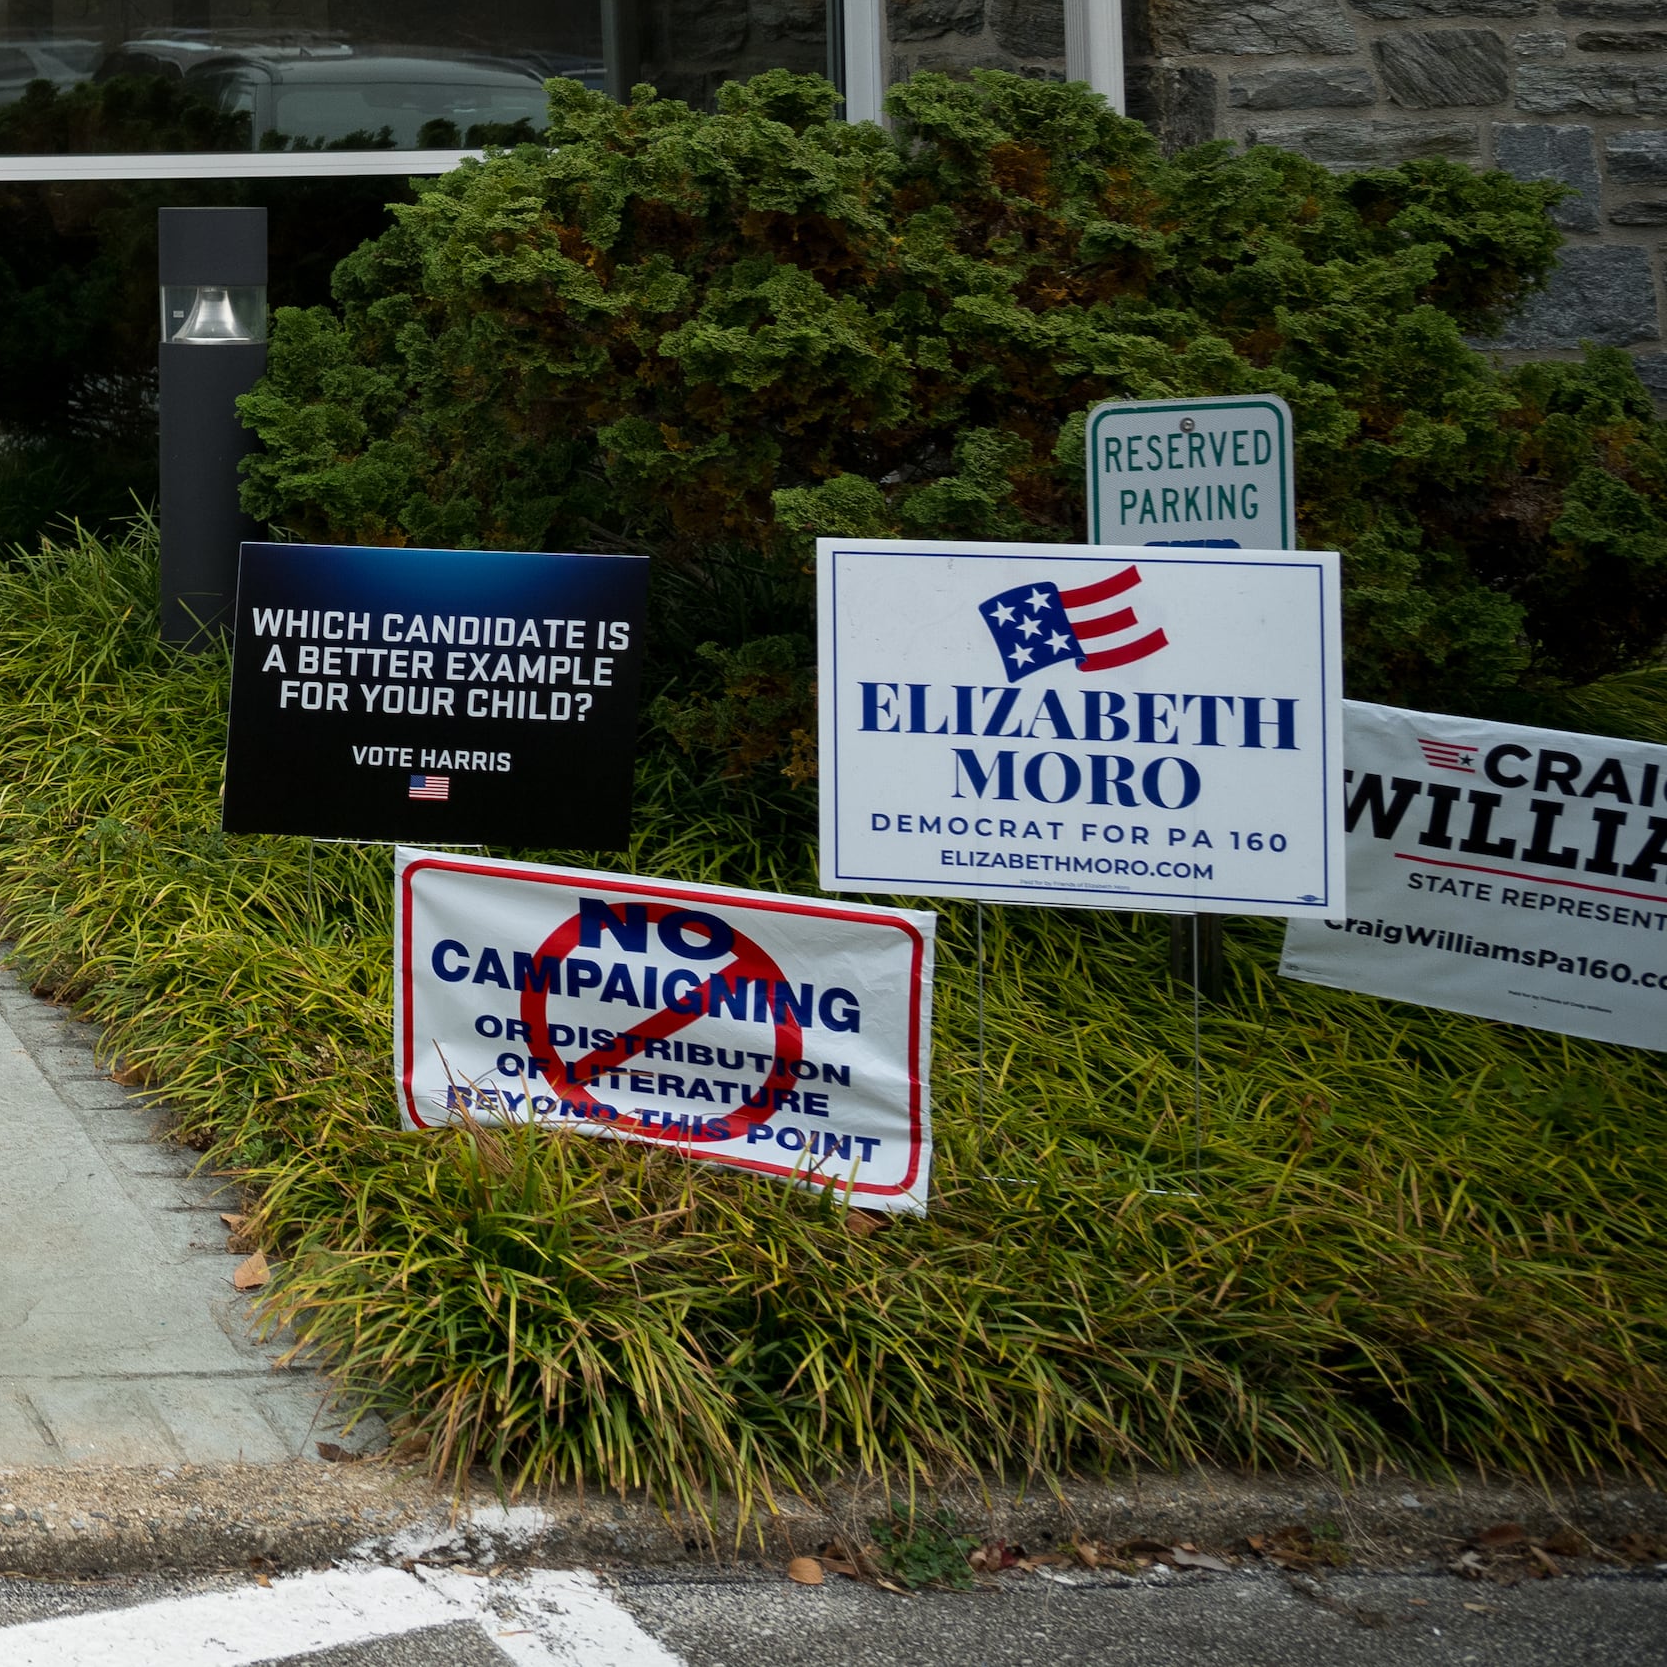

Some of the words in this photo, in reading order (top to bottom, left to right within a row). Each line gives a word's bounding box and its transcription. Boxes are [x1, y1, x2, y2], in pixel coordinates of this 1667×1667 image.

[1105, 429, 1272, 473] RESERVED
[1120, 483, 1259, 525] PARKING
[252, 607, 370, 641] WHICH
[382, 613, 586, 649] CANDIDATE
[596, 621, 630, 651] IS
[261, 643, 287, 673] A
[298, 645, 433, 680] BETTER
[446, 652, 614, 687] EXAMPLE
[279, 680, 348, 712] FOR
[360, 684, 455, 717] YOUR
[466, 688, 592, 722] CHILD?
[857, 681, 1301, 751] ELIZABETH
[352, 745, 413, 768] VOTE
[420, 749, 511, 772] HARRIS
[950, 748, 1201, 810] MORO
[1483, 743, 1667, 808] CRAI
[870, 812, 1064, 841] DEMOCRAT
[1081, 823, 1150, 846] FOR
[1168, 827, 1213, 849] PA
[1230, 831, 1288, 853] 160
[1343, 769, 1667, 883] WILLIA
[940, 849, 1213, 880] ELIZABETHMORO.COM
[579, 897, 734, 960] NO
[1407, 872, 1492, 902] STATE
[1500, 887, 1667, 931] REPRESENT
[431, 939, 861, 1034] CAMPAIGNING
[474, 1014, 532, 1044] OR
[549, 1024, 850, 1087] DISTRIBUTION
[496, 1052, 549, 1080] OF
[566, 1061, 829, 1118] LITERATURE
[446, 1085, 617, 1122] BEYOND
[633, 1107, 732, 1141] THIS
[746, 1123, 881, 1163] POINT
